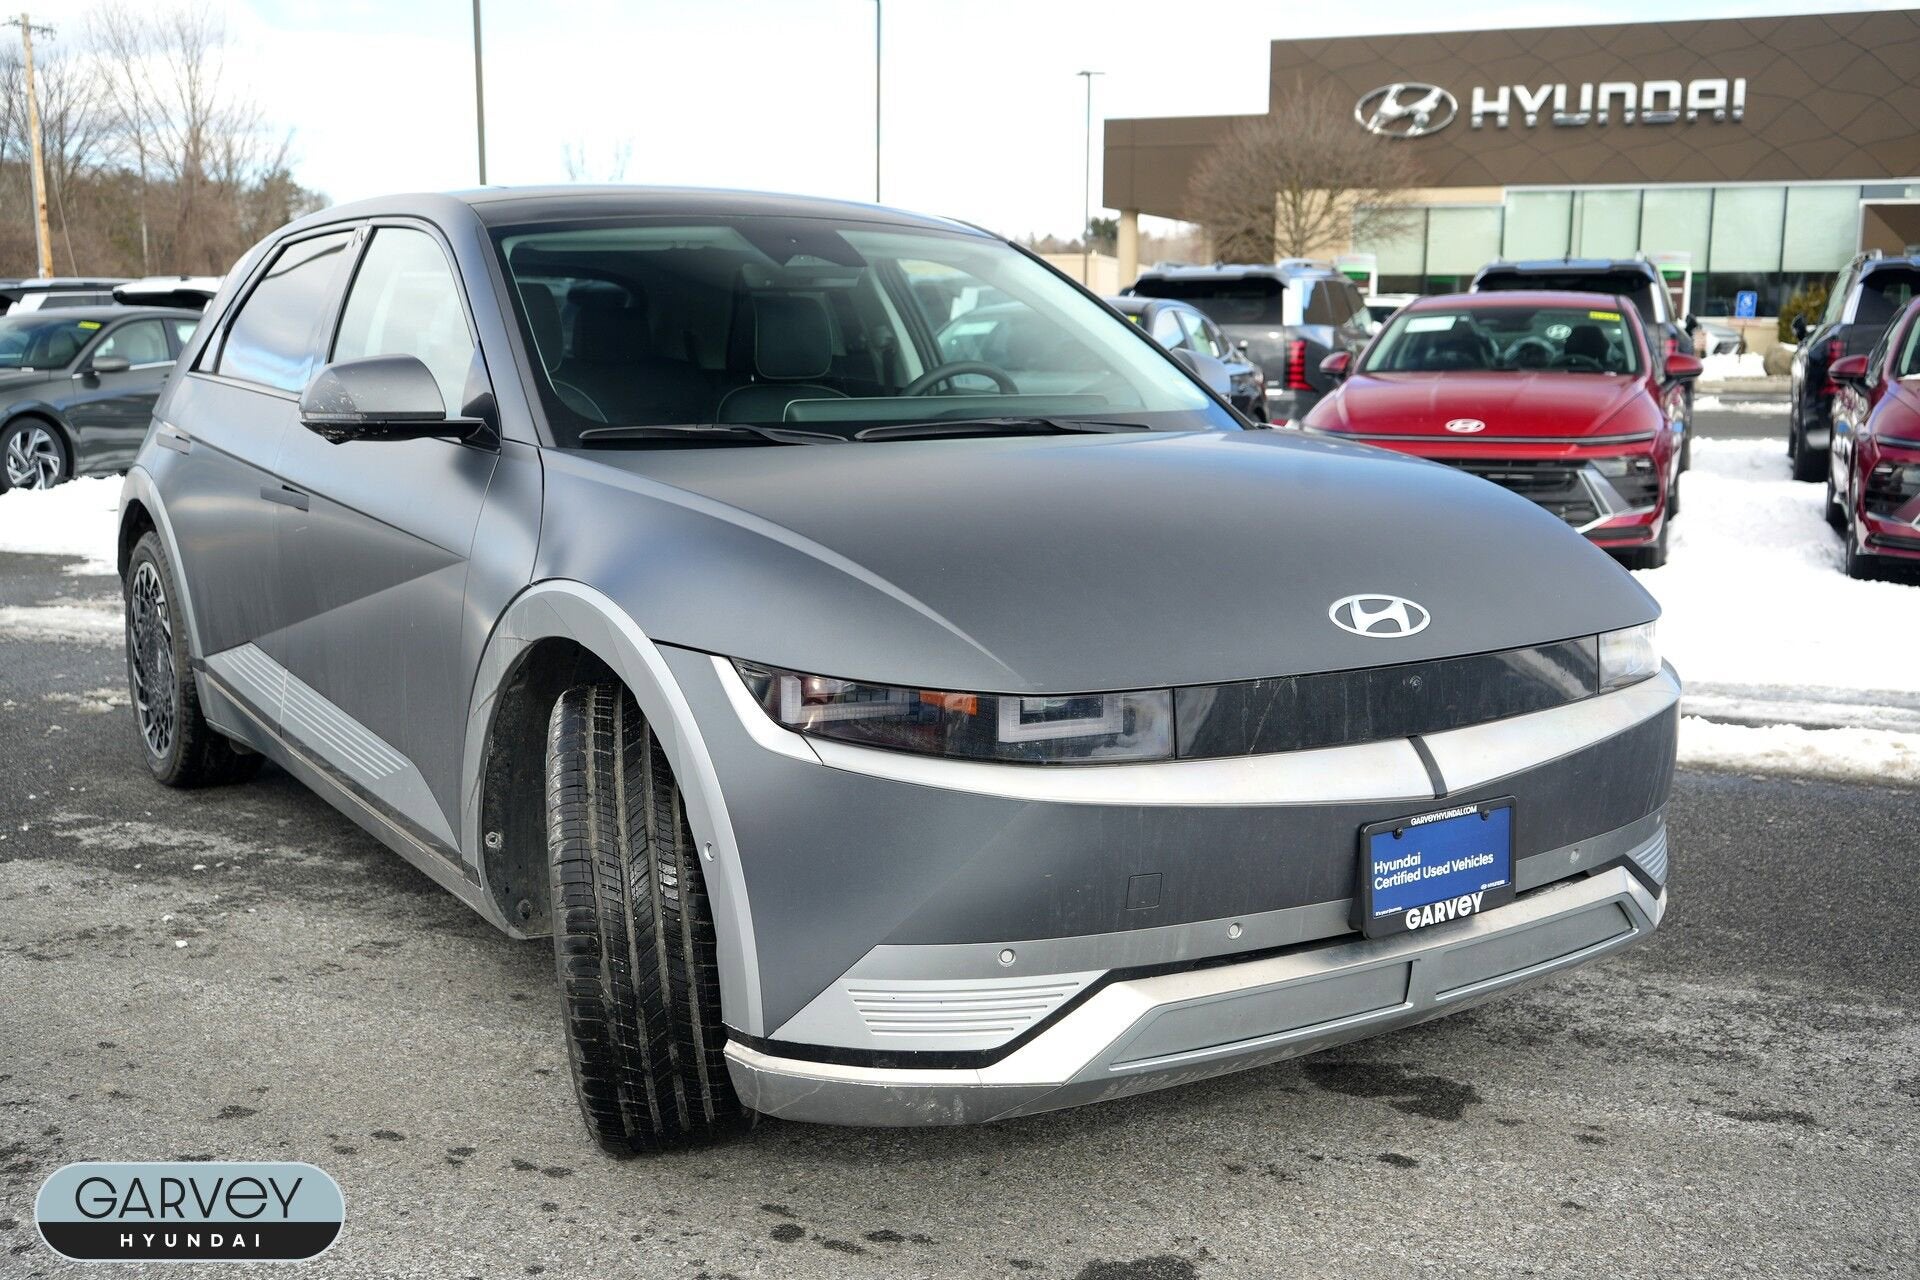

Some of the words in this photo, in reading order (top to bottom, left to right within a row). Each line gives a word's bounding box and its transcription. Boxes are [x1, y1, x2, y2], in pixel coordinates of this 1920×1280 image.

[1471, 78, 1747, 129] HYUNDAI
[1374, 852, 1421, 877] Hyundai
[1374, 868, 1421, 890] Certified
[1423, 861, 1450, 879] Used
[1452, 852, 1494, 872] Vehicles
